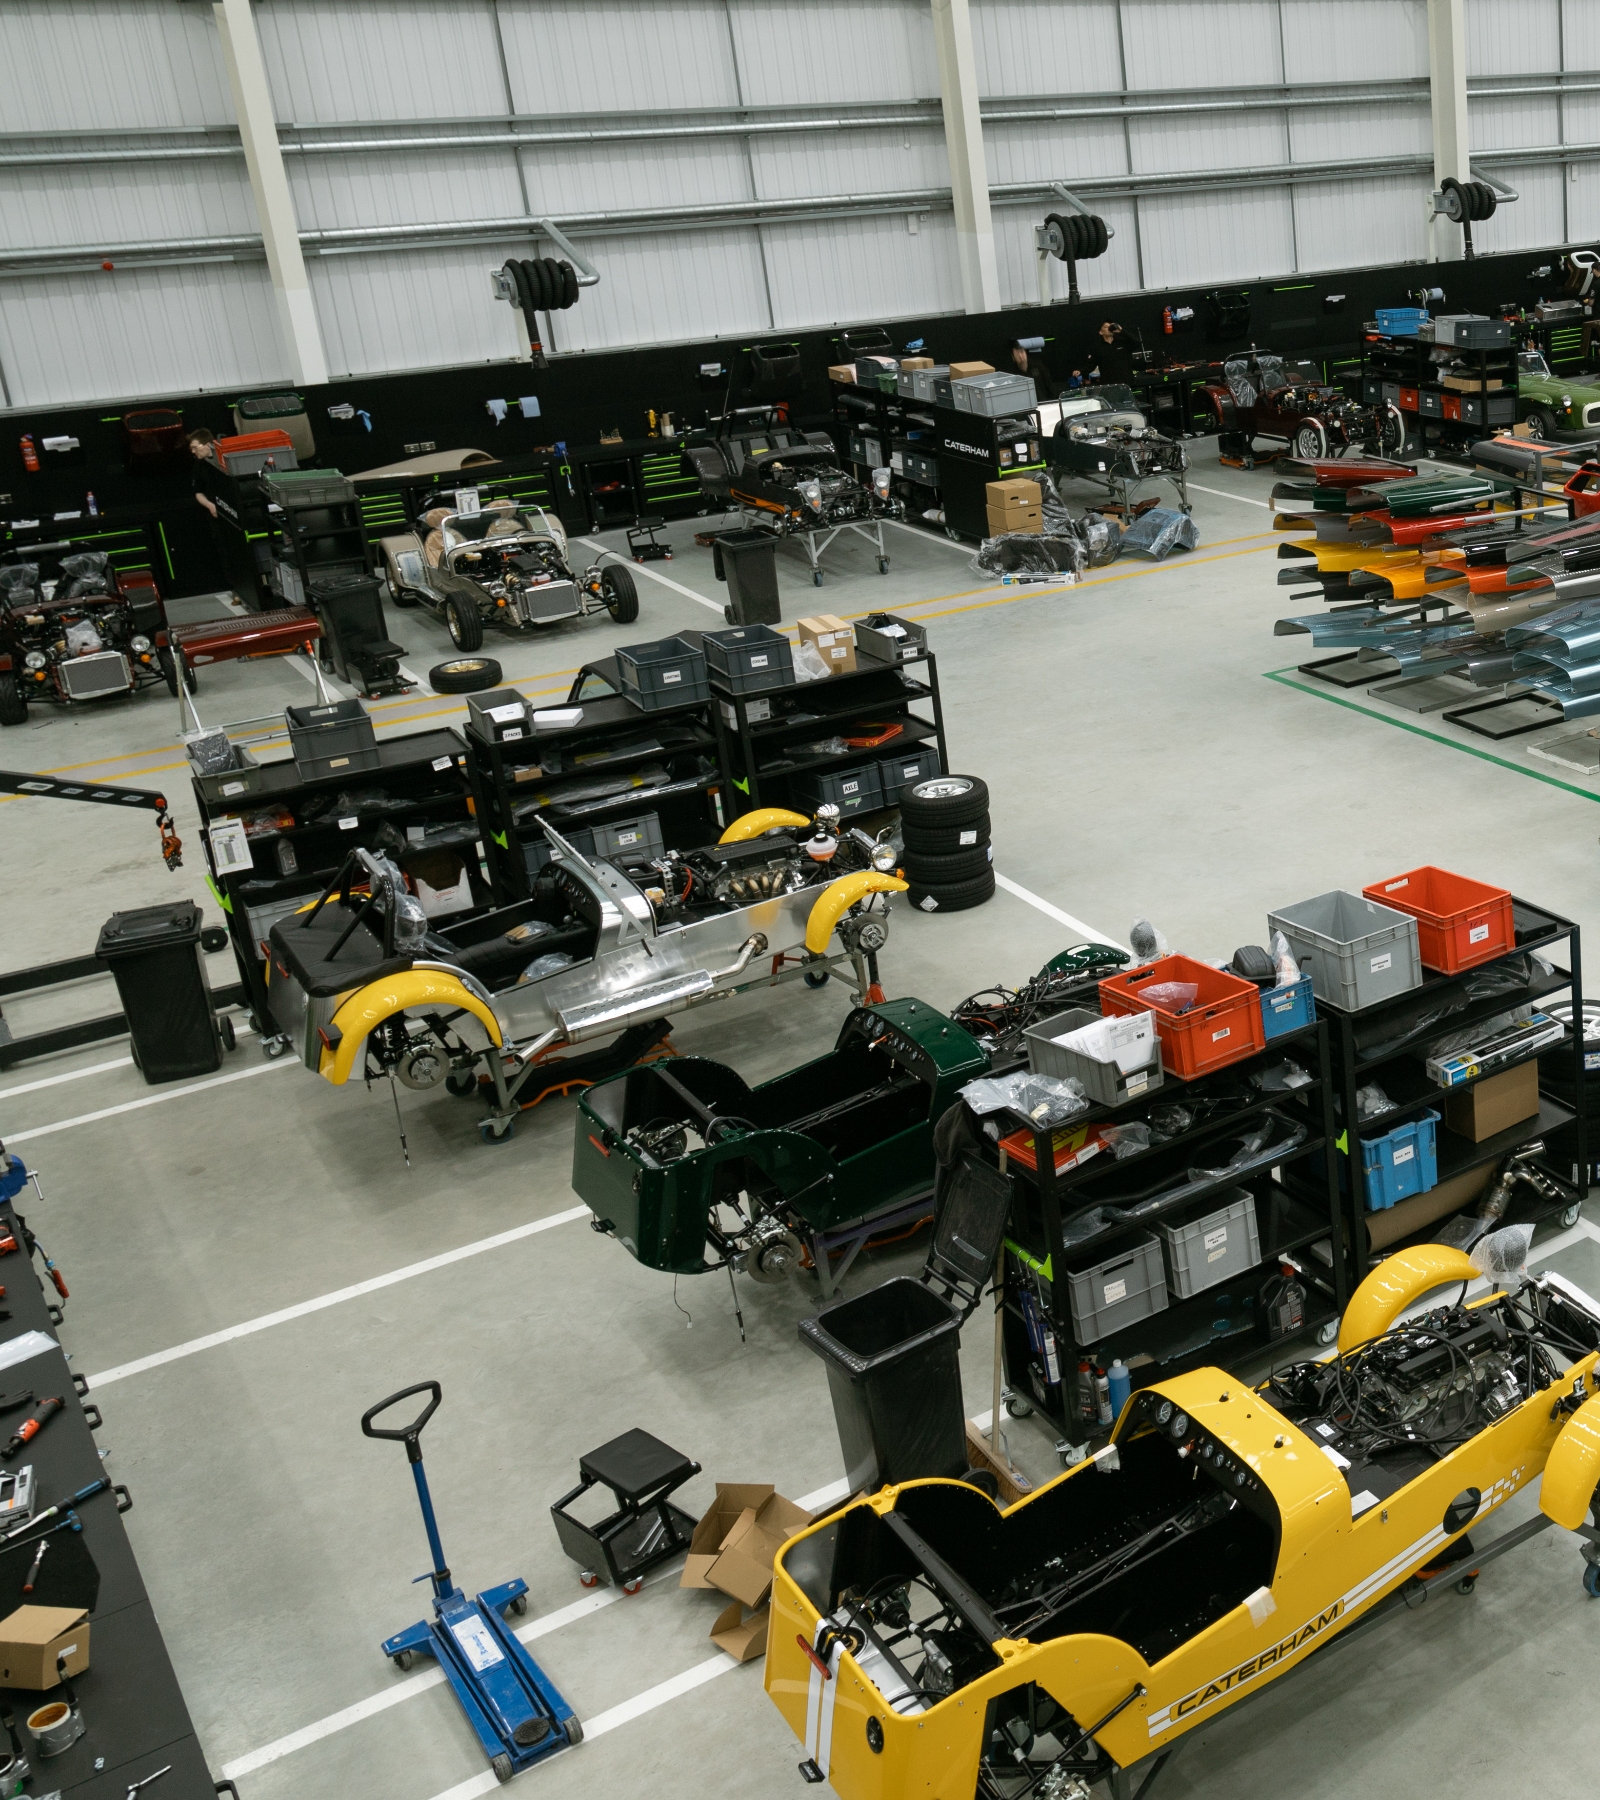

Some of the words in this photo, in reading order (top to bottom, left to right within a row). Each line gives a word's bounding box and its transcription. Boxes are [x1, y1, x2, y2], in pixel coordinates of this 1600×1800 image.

[944, 439, 989, 458] CATERHAM
[6, 532, 13, 540] 2
[844, 782, 857, 792] AXLE
[1177, 1603, 1338, 1717] CATERHAM
